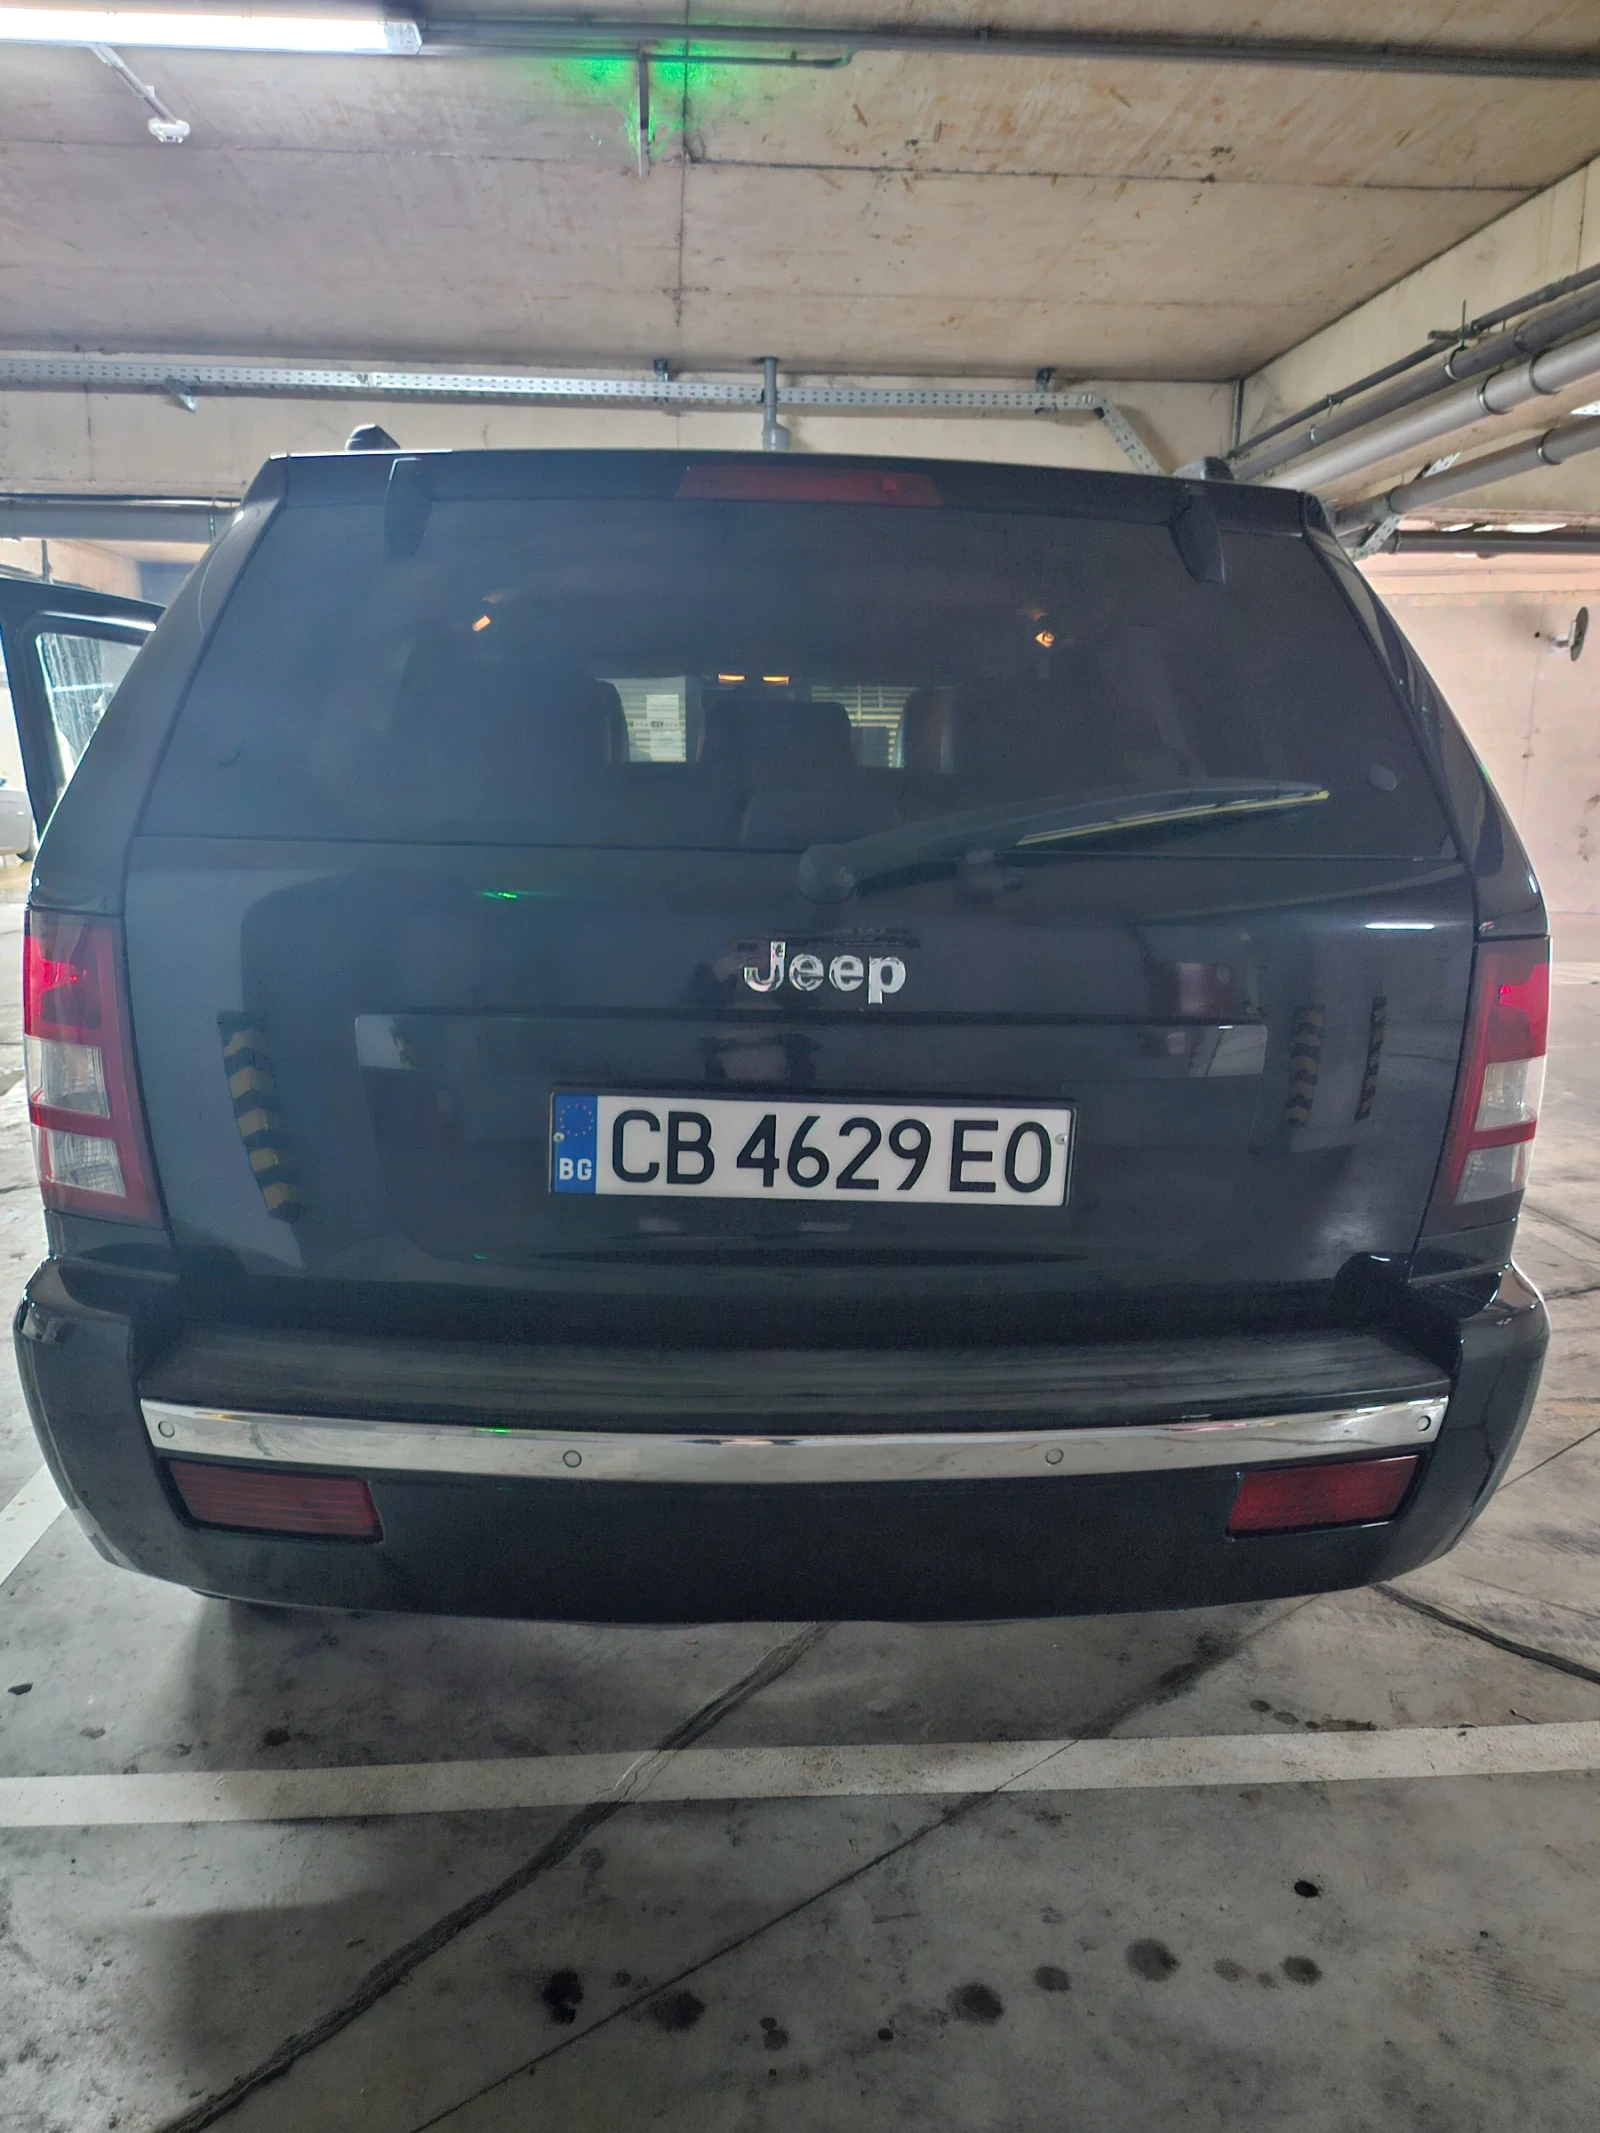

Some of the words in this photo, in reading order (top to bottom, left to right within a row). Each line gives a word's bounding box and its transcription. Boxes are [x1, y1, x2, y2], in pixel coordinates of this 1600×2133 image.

[743, 941, 907, 1005] Jeep
[558, 1157, 593, 1182] BG
[611, 1109, 716, 1185] CB
[735, 1113, 933, 1191] 4629
